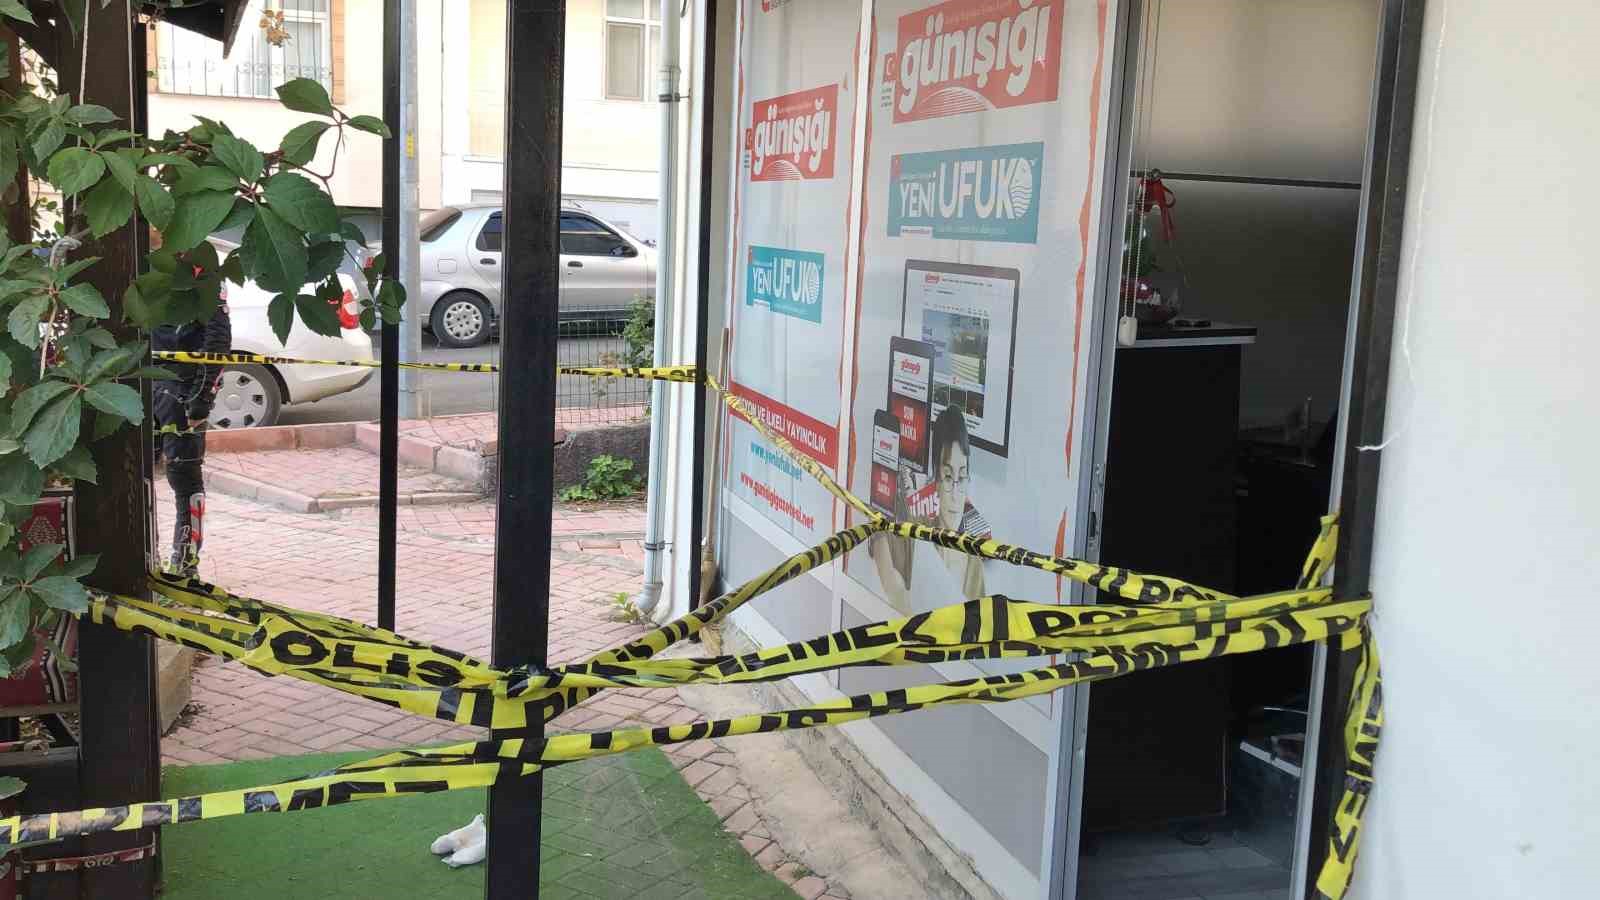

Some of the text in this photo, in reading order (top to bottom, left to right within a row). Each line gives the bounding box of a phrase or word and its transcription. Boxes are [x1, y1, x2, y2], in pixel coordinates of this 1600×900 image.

[898, 0, 1052, 114] günışığı
[753, 97, 831, 175] günışığı
[900, 157, 1015, 219] YENİ UFUK
[773, 256, 810, 304] UFUK
[786, 418, 826, 455] YAYINCILIK
